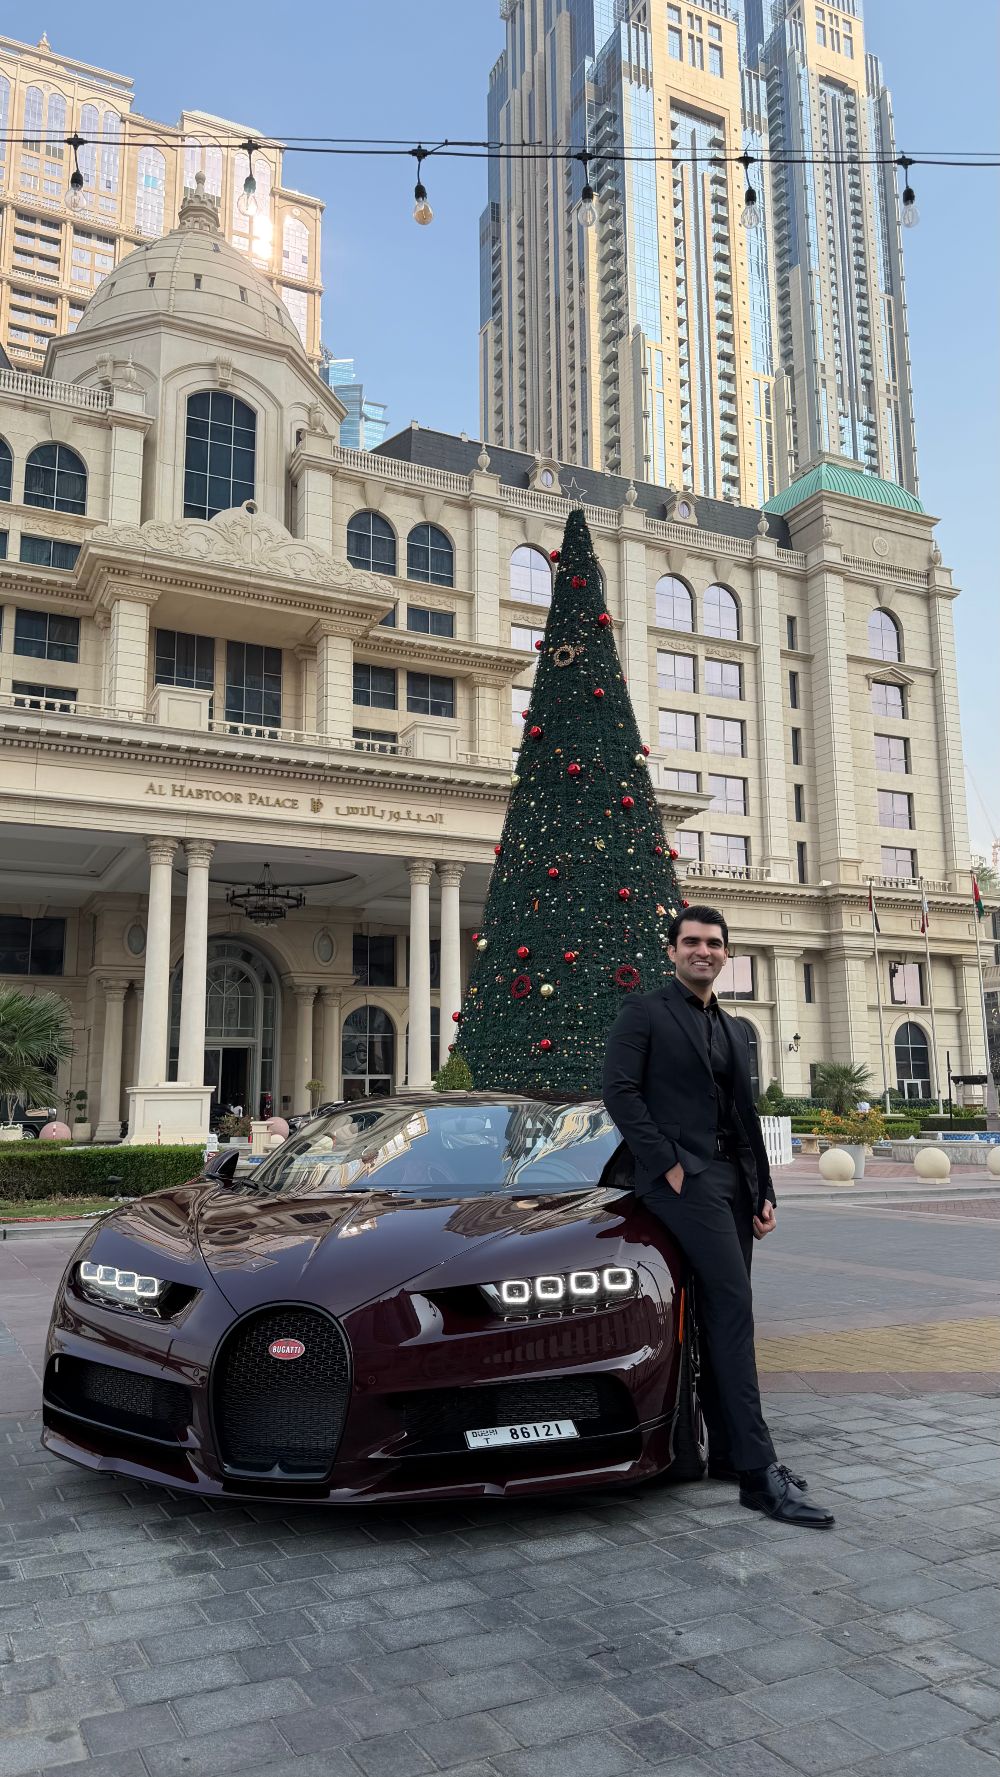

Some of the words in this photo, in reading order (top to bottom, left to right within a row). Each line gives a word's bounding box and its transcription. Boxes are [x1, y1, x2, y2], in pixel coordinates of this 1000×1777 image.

[145, 781, 166, 796] AL
[171, 783, 243, 804] HABTOOR
[248, 792, 300, 810] PALACE
[272, 1345, 301, 1354] BUGATTI
[509, 1423, 562, 1440] 86121
[483, 1437, 491, 1445] T
